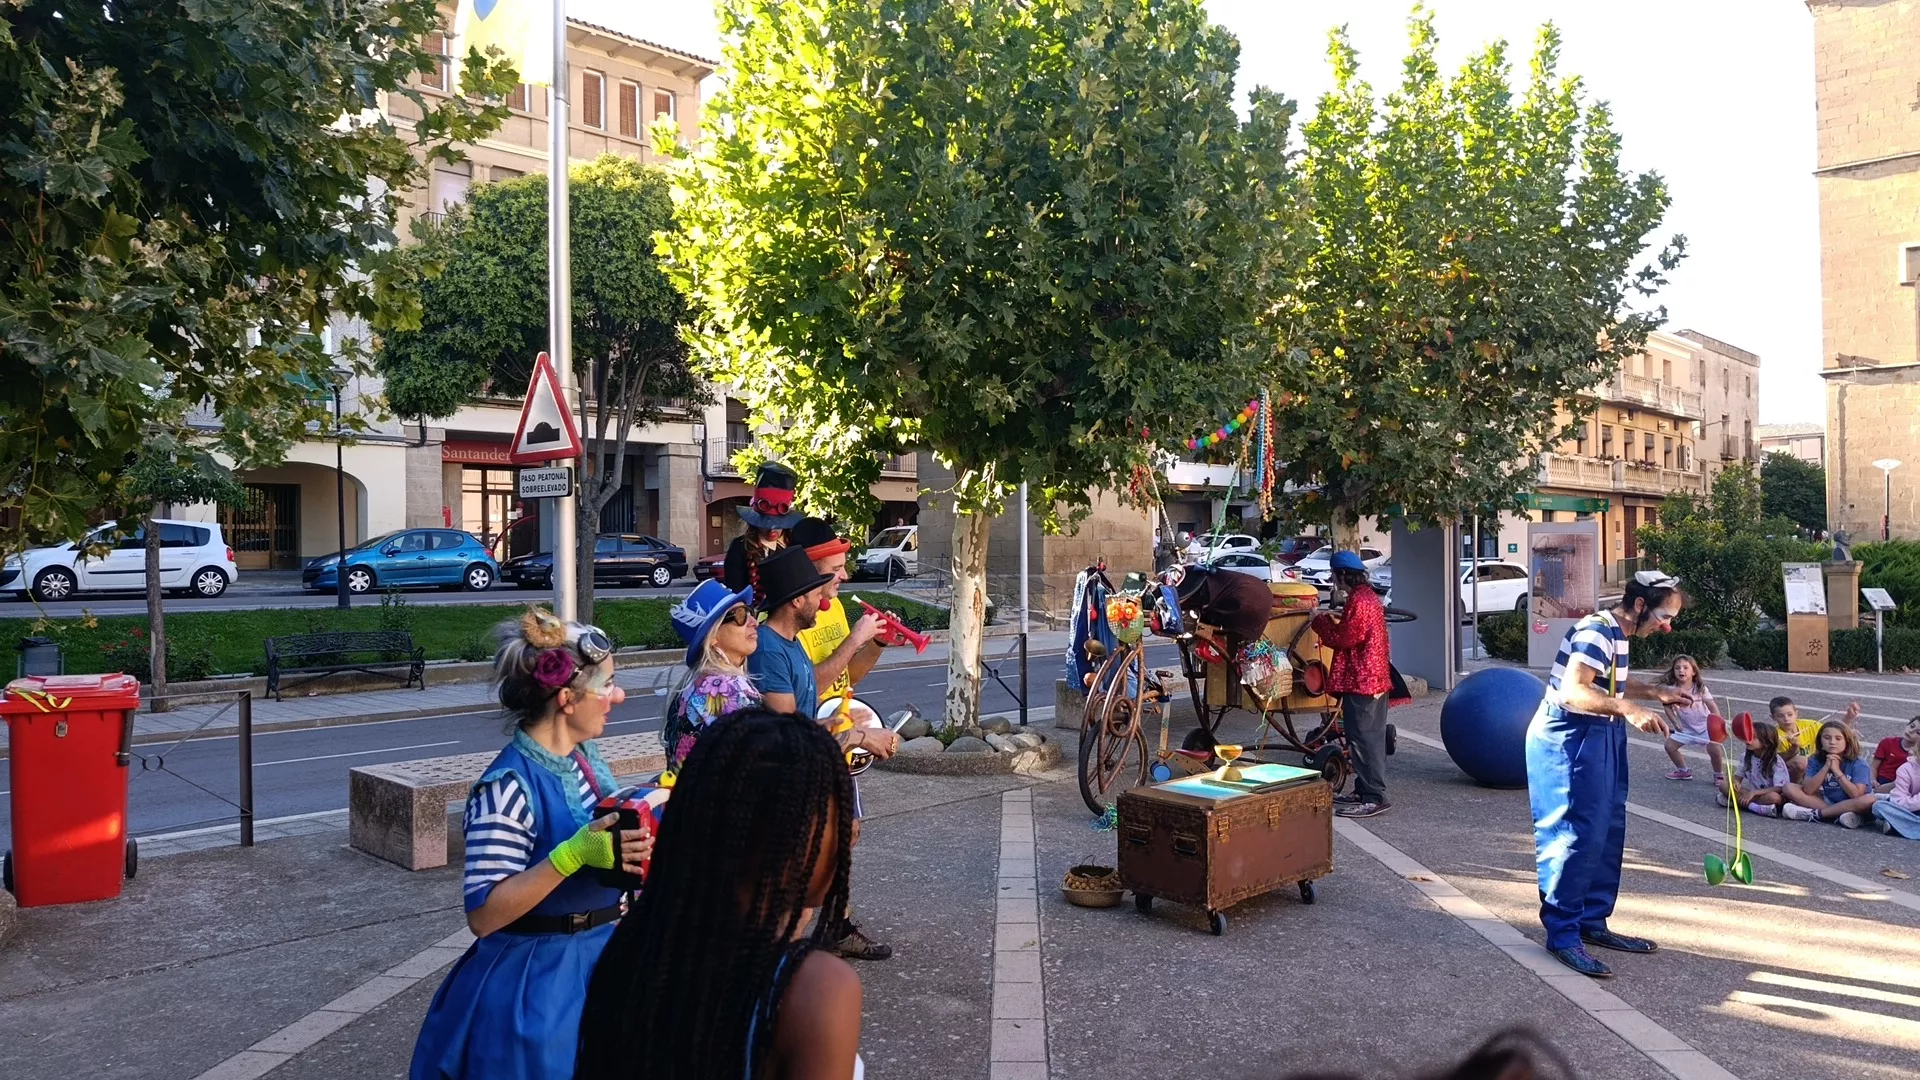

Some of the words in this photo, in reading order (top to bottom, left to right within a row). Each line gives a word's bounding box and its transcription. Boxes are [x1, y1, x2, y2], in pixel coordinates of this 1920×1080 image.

[442, 445, 511, 461] Santander
[521, 474, 536, 482] PASO
[538, 472, 566, 481] PEATONAL
[522, 484, 566, 494] SOBREELEVADO
